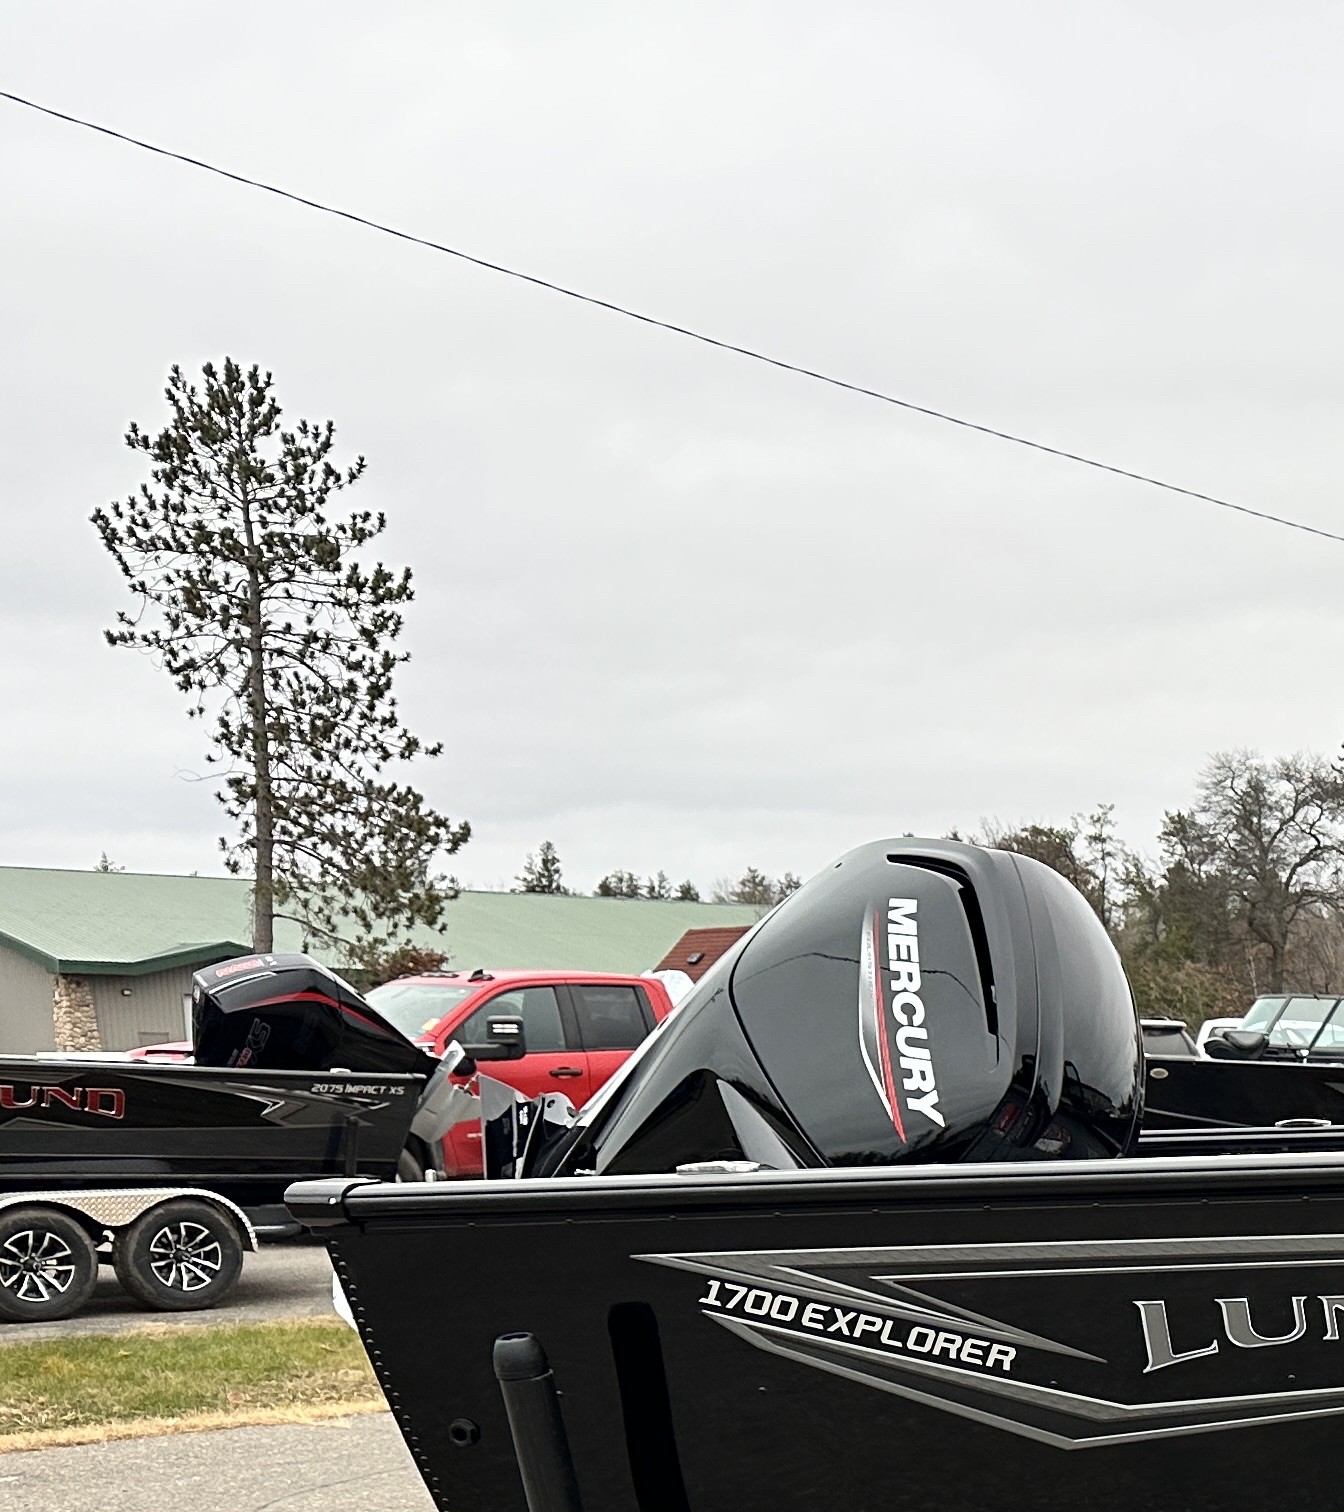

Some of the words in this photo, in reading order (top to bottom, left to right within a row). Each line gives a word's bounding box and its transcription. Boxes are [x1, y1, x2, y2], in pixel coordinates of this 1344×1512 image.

[887, 898, 945, 1127] MERCURY
[0, 1084, 125, 1120] UND
[311, 1083, 344, 1094] 2075
[345, 1083, 387, 1095] IMPACT
[388, 1085, 406, 1096] XS
[698, 1279, 799, 1323] 1700
[800, 1303, 1017, 1372] EXPLORER
